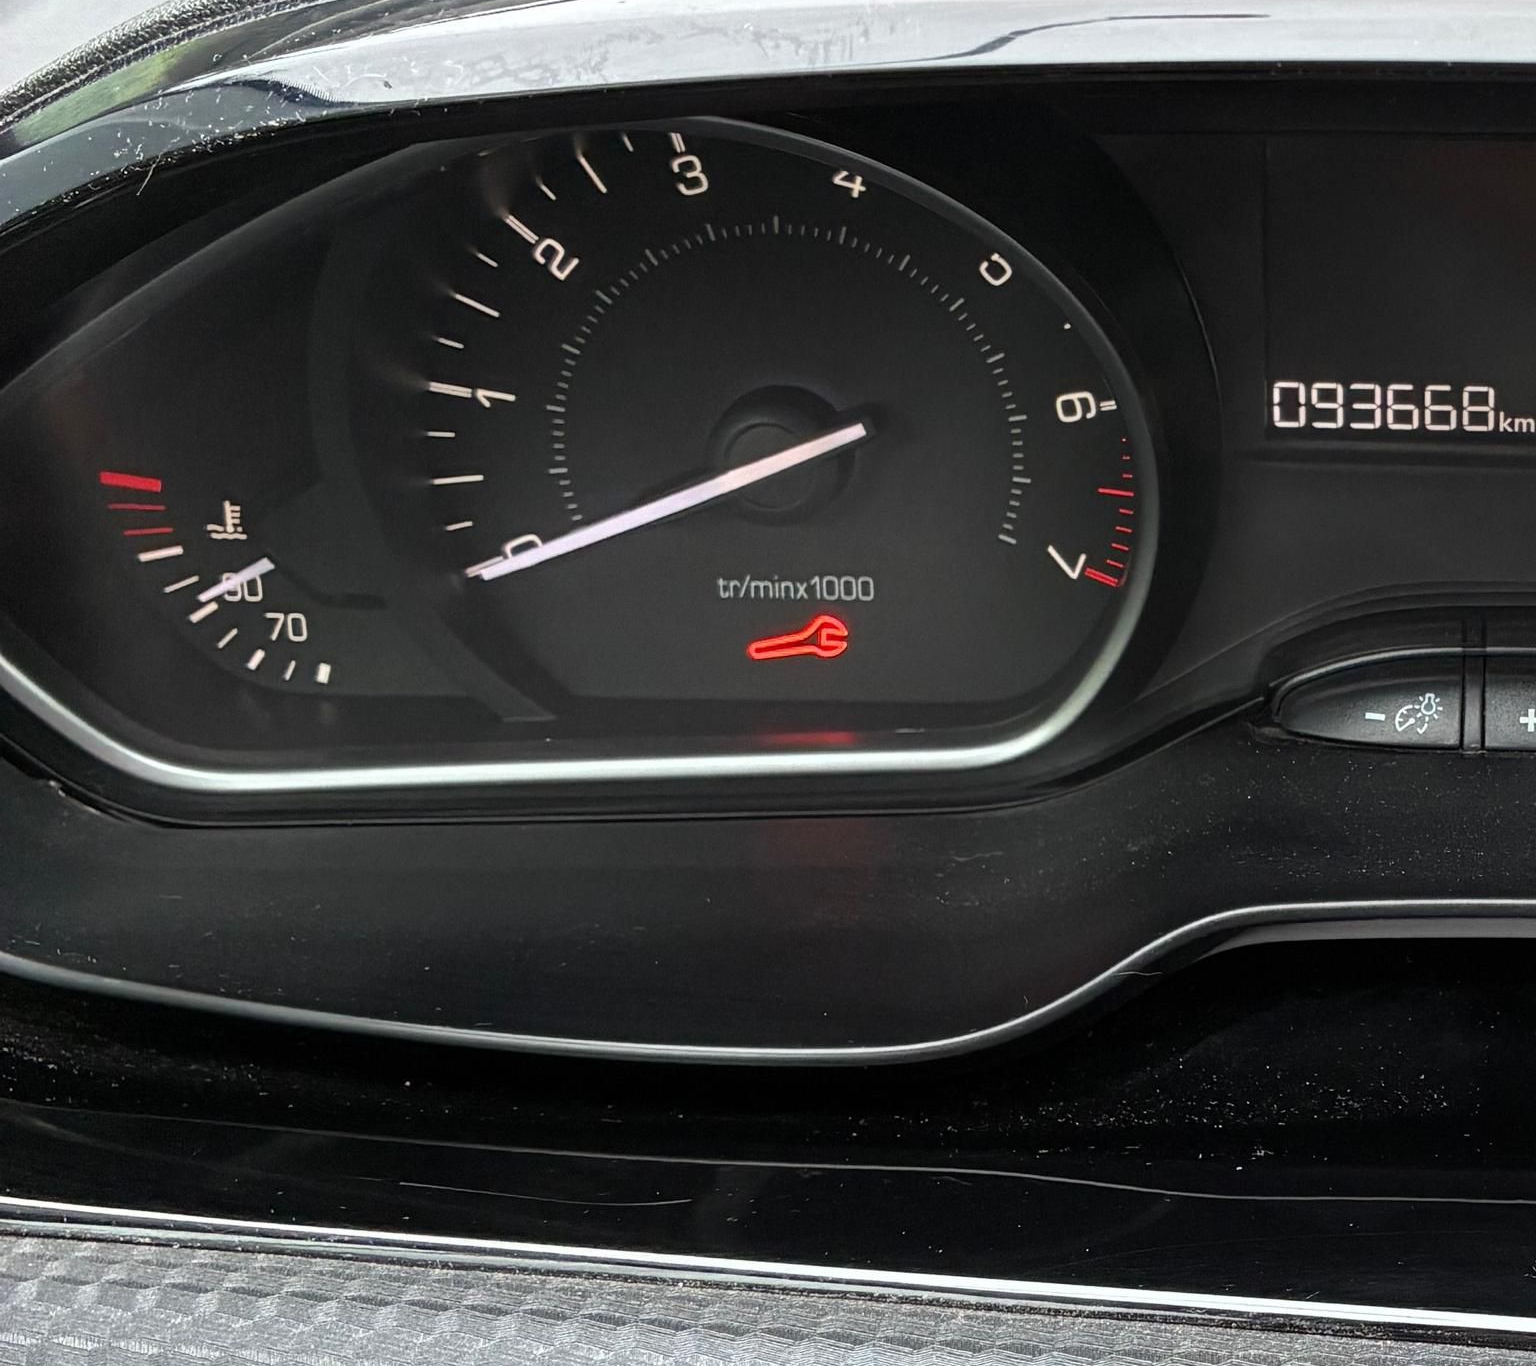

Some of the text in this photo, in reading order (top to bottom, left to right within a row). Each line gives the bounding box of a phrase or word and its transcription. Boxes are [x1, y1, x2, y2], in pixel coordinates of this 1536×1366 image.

[671, 154, 709, 196] 3
[832, 170, 866, 198] 4
[533, 238, 580, 281] 2
[474, 388, 516, 408] 1
[1055, 390, 1097, 423] 6
[1272, 380, 1536, 433] 093668 km
[1047, 544, 1087, 580] 7
[717, 574, 875, 602] tr/minx1000
[264, 611, 309, 643] 70
